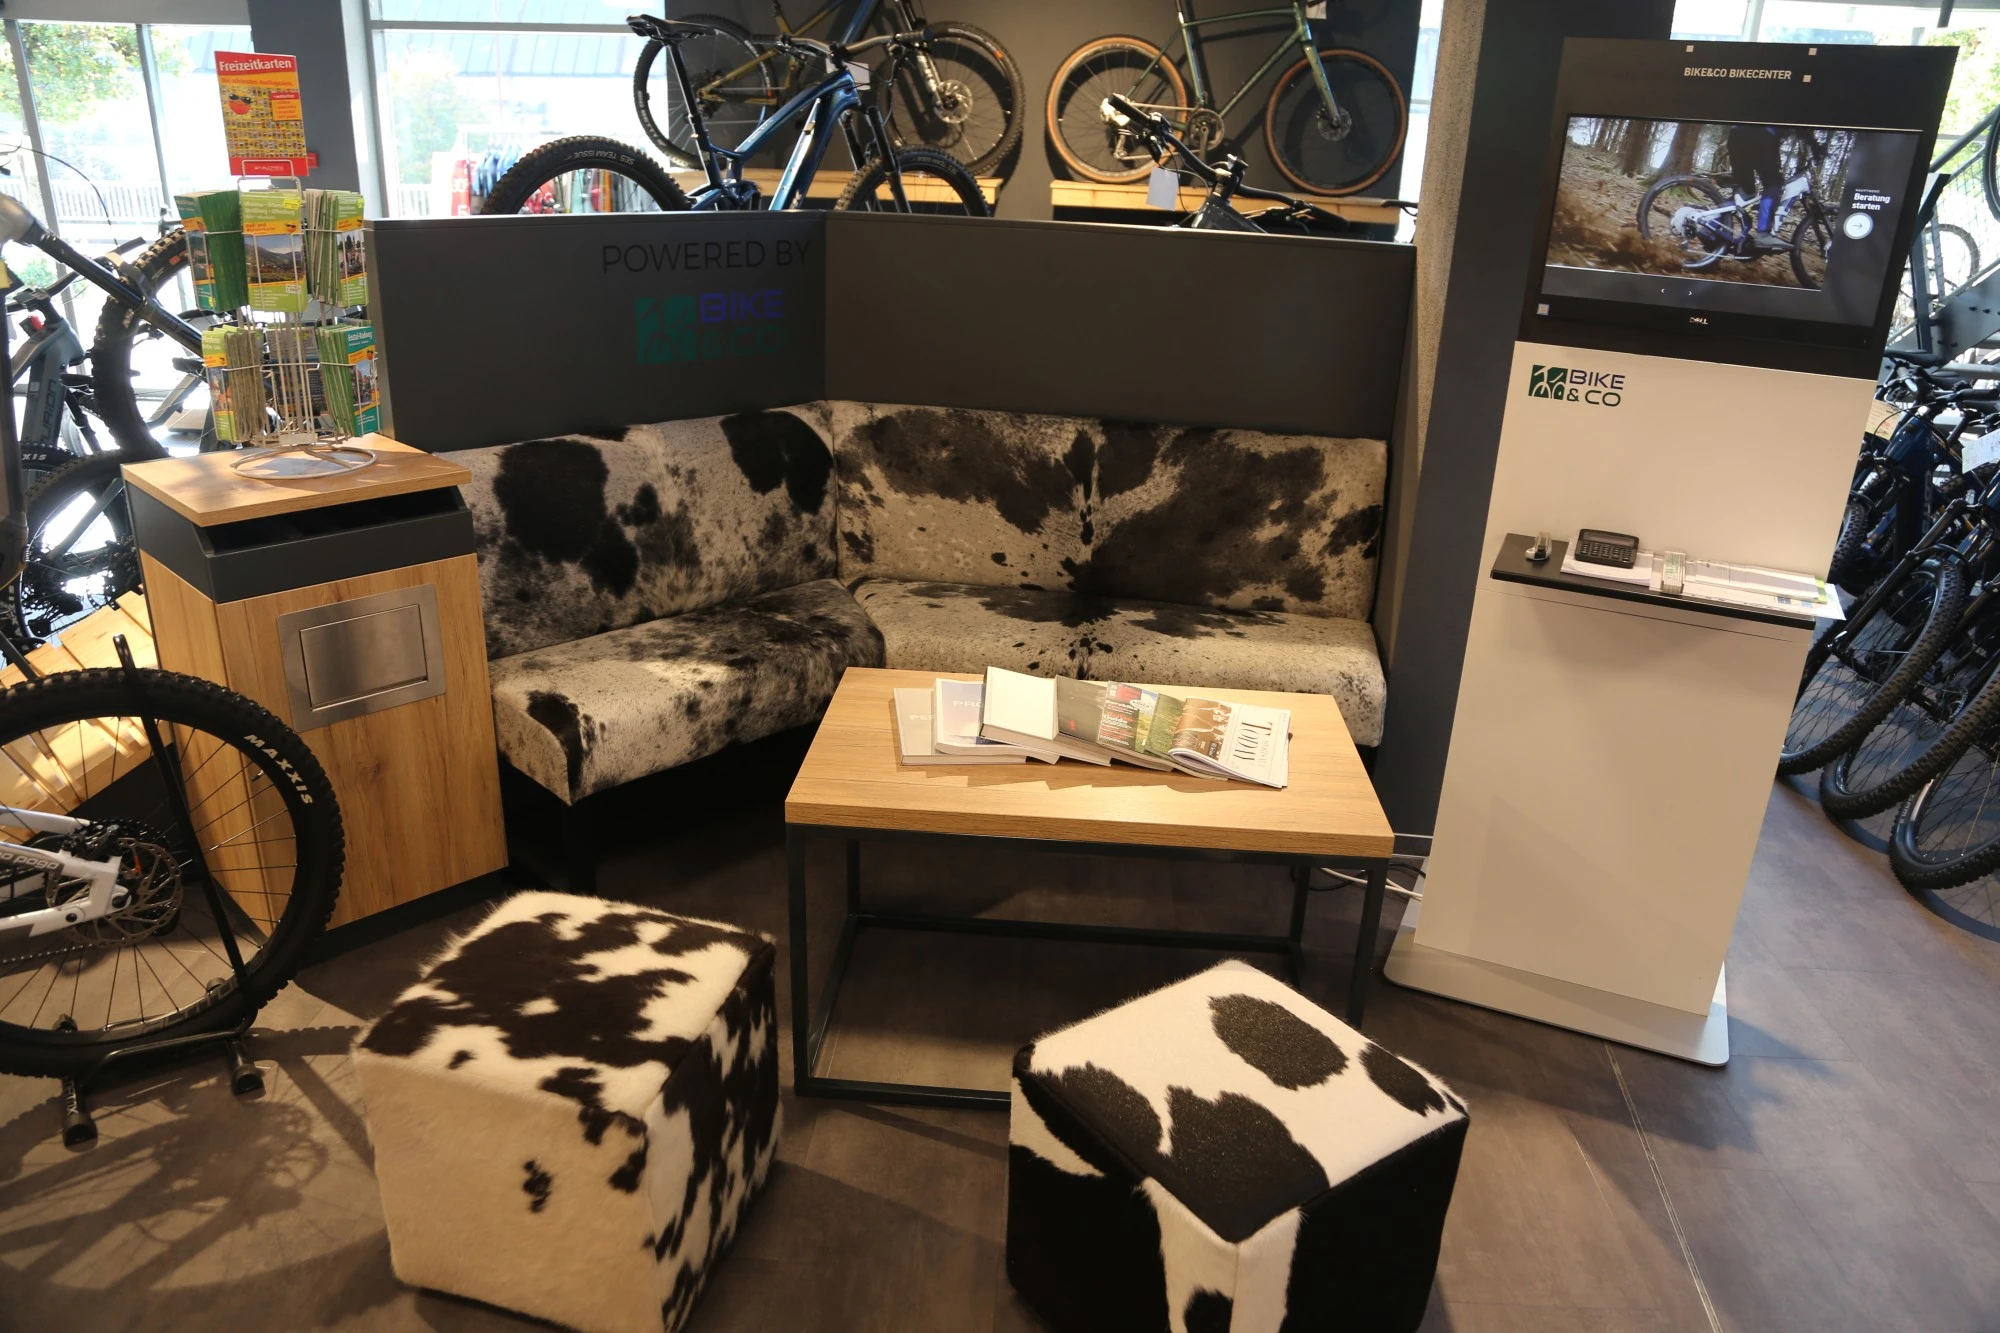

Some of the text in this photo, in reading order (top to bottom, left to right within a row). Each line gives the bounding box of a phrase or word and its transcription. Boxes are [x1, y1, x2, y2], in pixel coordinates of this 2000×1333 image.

[219, 58, 292, 71] Freizeitkarten
[1684, 67, 1792, 80] BIKE&CO BIKECENTER
[1854, 193, 1890, 204] Beratung
[602, 239, 811, 274] POWERED BY
[700, 289, 785, 323] BIKE
[1689, 316, 1708, 325] DELL
[1569, 369, 1626, 390] BIKE
[1585, 390, 1621, 407] CO
[22, 453, 47, 461] XIS
[243, 734, 313, 804] MAXXIS
[13, 855, 59, 870] pogo
